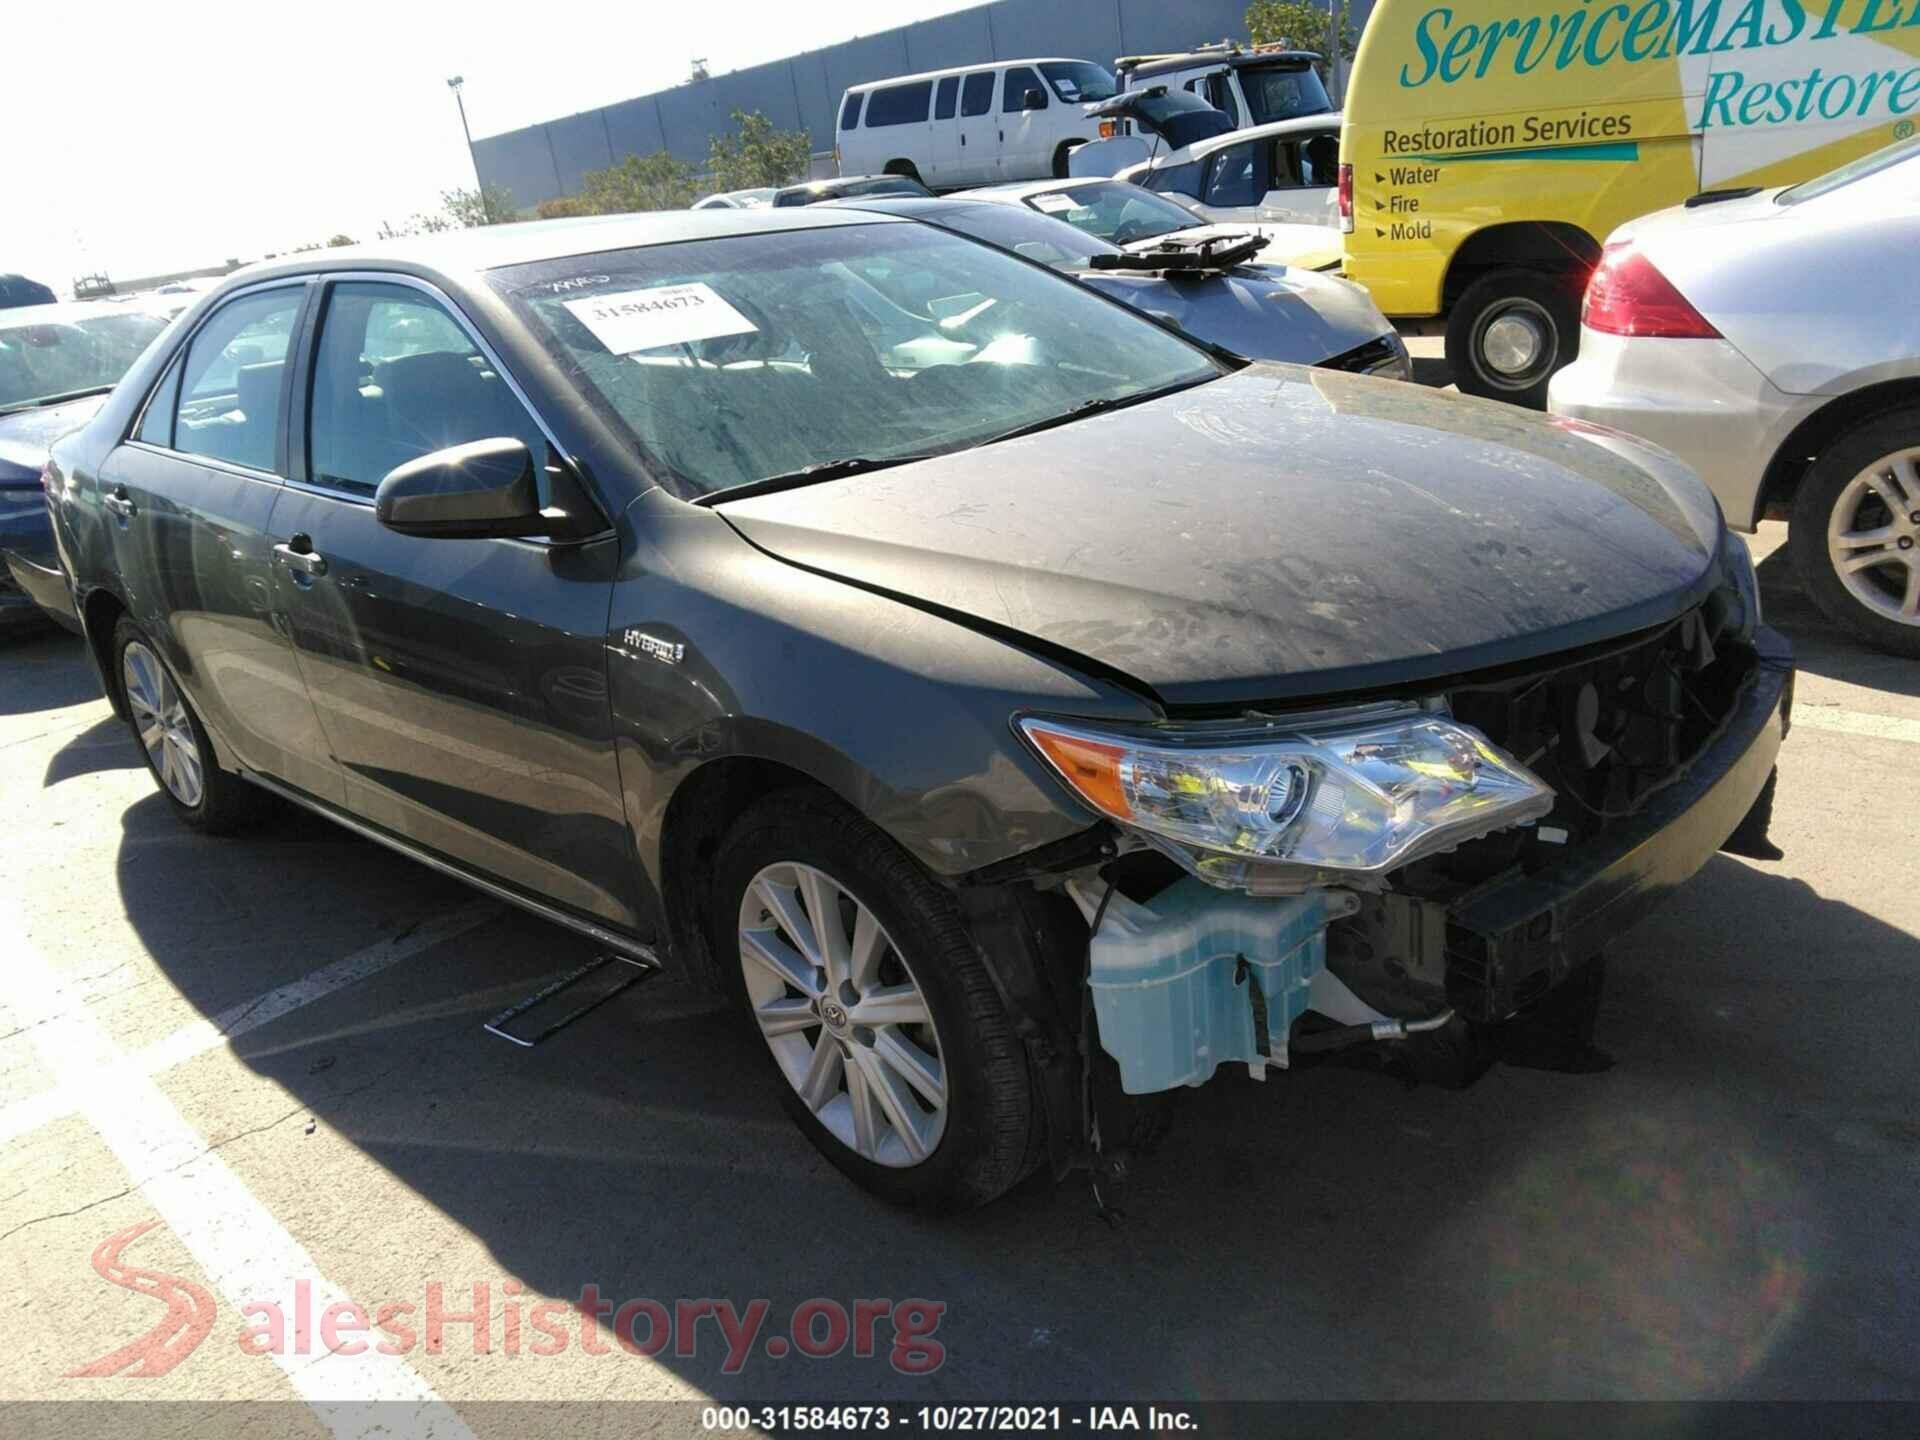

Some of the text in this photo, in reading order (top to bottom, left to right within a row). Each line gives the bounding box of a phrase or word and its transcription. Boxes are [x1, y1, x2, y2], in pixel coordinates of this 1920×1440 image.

[1400, 0, 1920, 88] ServiceMASTE
[1693, 68, 1920, 129] Restore
[1383, 112, 1632, 154] Restoration Services
[1390, 166, 1440, 185] Water
[1390, 195, 1419, 213] Fire
[1390, 222, 1431, 240] Mold
[592, 295, 705, 320] 31584673
